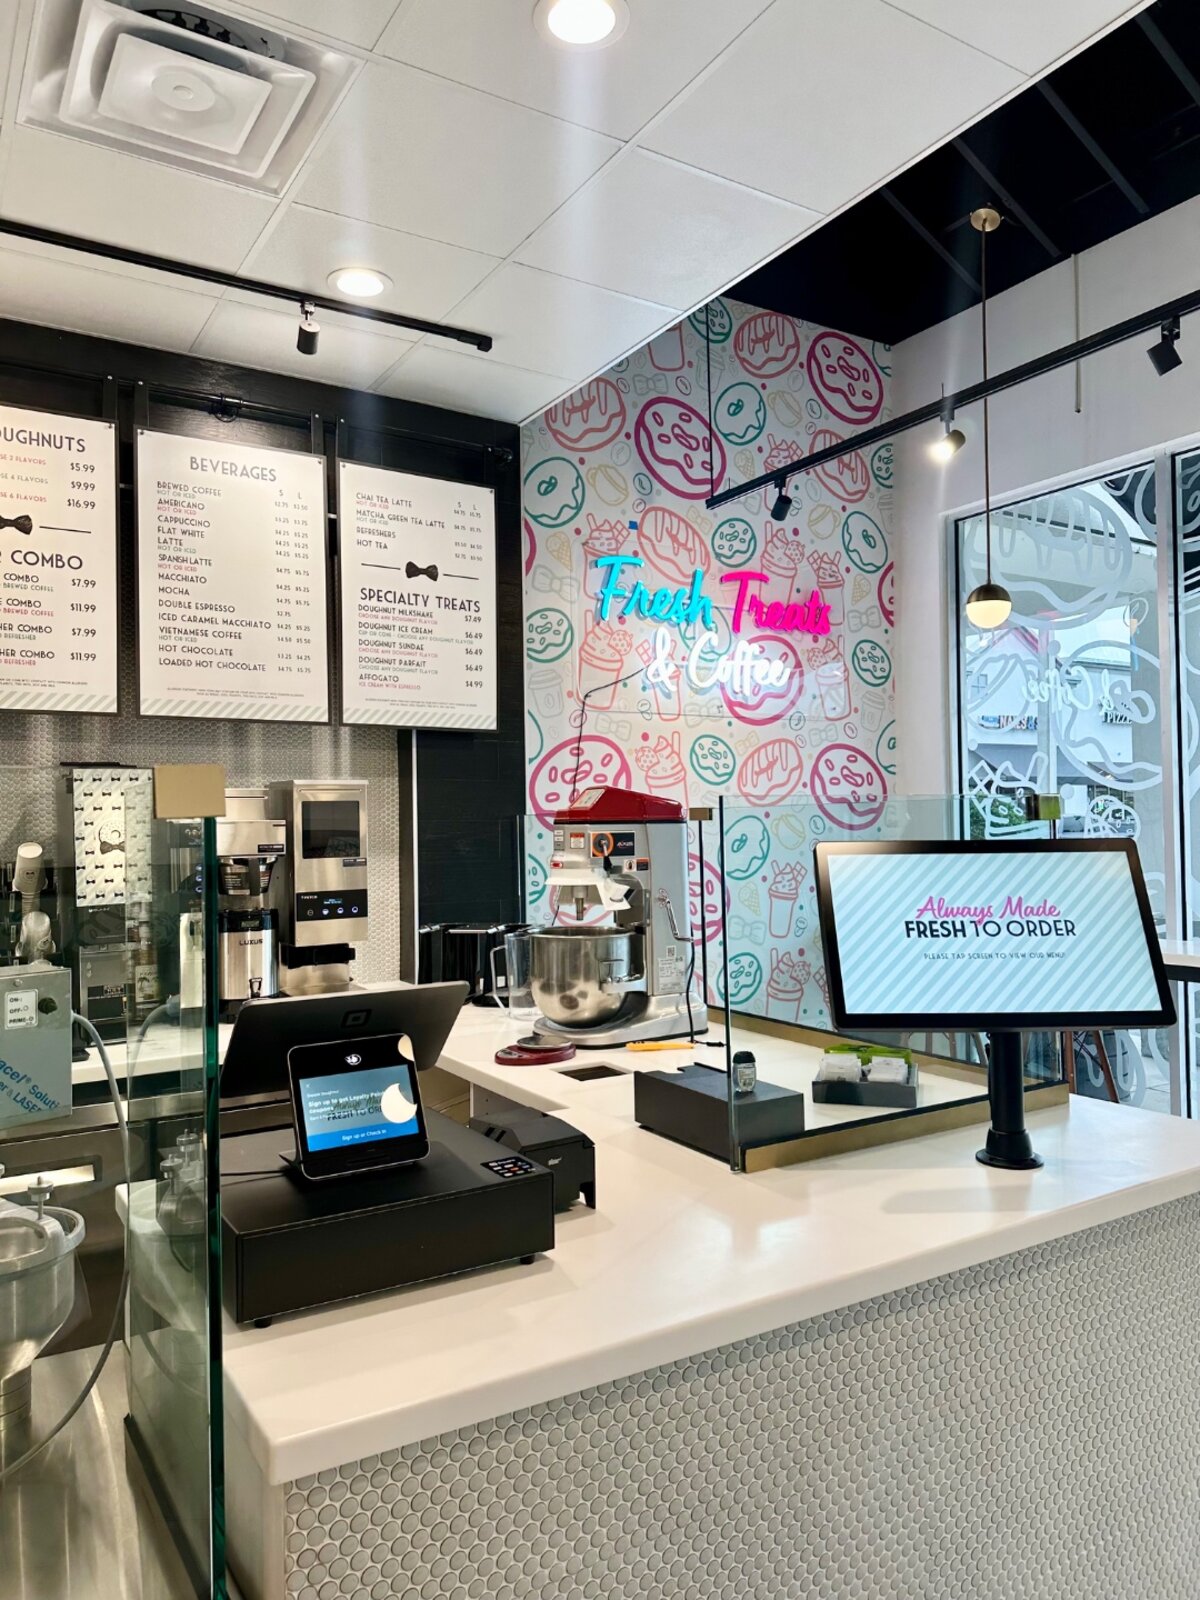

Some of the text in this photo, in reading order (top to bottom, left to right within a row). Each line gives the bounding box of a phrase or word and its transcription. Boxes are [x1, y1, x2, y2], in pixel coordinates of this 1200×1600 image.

[0, 427, 86, 452] UGHNUTS
[70, 462, 94, 472] $5.99
[190, 456, 277, 482] BEVERAGES
[71, 481, 95, 491] $9.99
[157, 481, 222, 497] BREWED COFFEE
[67, 498, 96, 509] $16.99
[158, 498, 206, 511] AMERICANO
[376, 495, 389, 504] TEA
[392, 498, 412, 508] LATTE
[158, 515, 210, 528] CAPPUCCINO
[356, 508, 385, 520] MATCHA
[411, 516, 424, 526] TEA
[425, 519, 446, 529] LATTE
[158, 526, 176, 536] FLAT
[356, 526, 396, 538] REFRESHERS
[158, 536, 184, 546] LATTE
[356, 539, 388, 550] HOT TEA
[11, 550, 82, 570] COMBO
[4, 573, 39, 582] COMBO
[72, 579, 96, 588] $7.99
[158, 572, 208, 584] MACCHIATO
[158, 586, 190, 596] MOCHA
[594, 555, 832, 636] Fresh Treats
[6, 598, 41, 608] COMBO
[158, 599, 236, 613] DOUBLE ESPRESSO
[360, 587, 481, 612] SPECIALTY TREATS
[70, 604, 96, 612] $11.99
[358, 604, 434, 618] DOUGHNUT MILKSHAKE
[158, 612, 272, 629] ICED CARAMEL MACCHIATO
[18, 624, 52, 634] COMBO
[72, 628, 96, 637] $7.99
[159, 626, 242, 640] VIETNAMESE COFFEE
[358, 622, 396, 632] DOUGHNUT
[410, 626, 433, 635] CREAM
[158, 644, 234, 657] HOT CHOCOLATE
[358, 638, 424, 651] DOUGHNUT SUNDAE
[20, 650, 55, 659] COMBO
[70, 653, 96, 661] $11.99
[158, 658, 266, 672] LOADED HOT CHOCOLATE
[358, 656, 426, 668] DOUGHNUT PARFAIT
[645, 626, 791, 697] & Coffee
[358, 674, 400, 682] AFFOGATO
[915, 896, 1060, 925] Always Made
[904, 920, 1076, 938] FRESH TO ORDER
[239, 938, 264, 946] LUXUS
